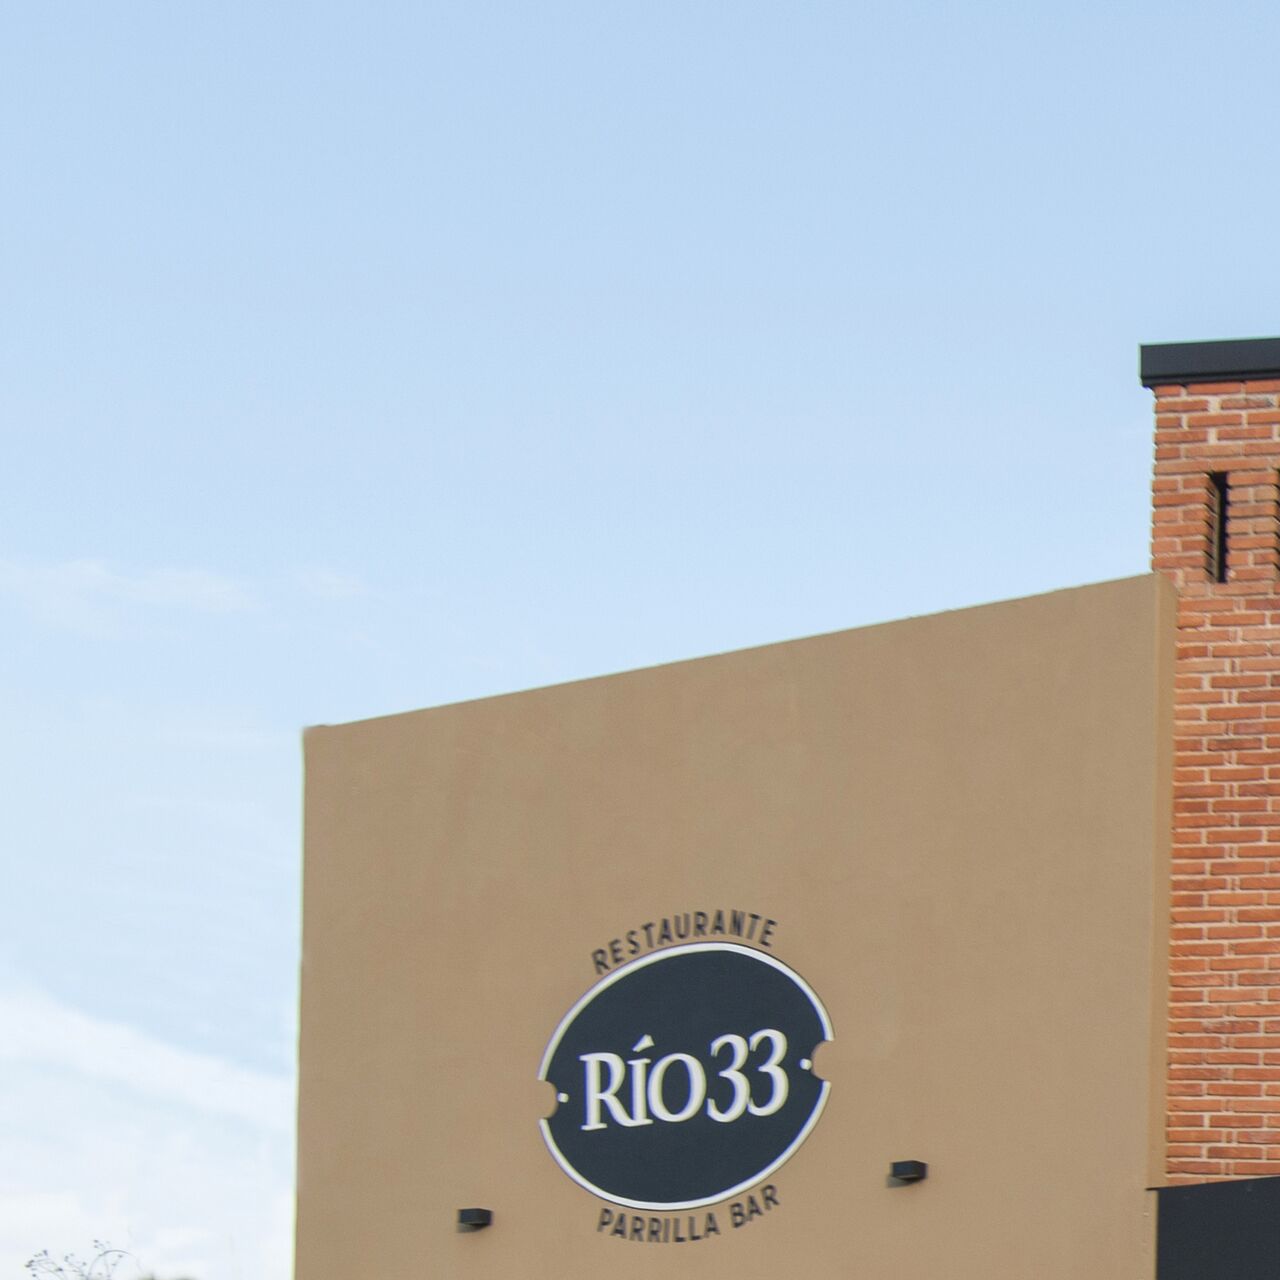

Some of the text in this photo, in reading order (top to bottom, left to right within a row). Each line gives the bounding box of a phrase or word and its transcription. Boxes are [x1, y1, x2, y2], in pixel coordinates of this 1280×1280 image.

[591, 909, 777, 975] RESTAURANTE
[579, 1029, 790, 1131] RÍO33
[597, 1184, 780, 1243] PARRILLA BAR
